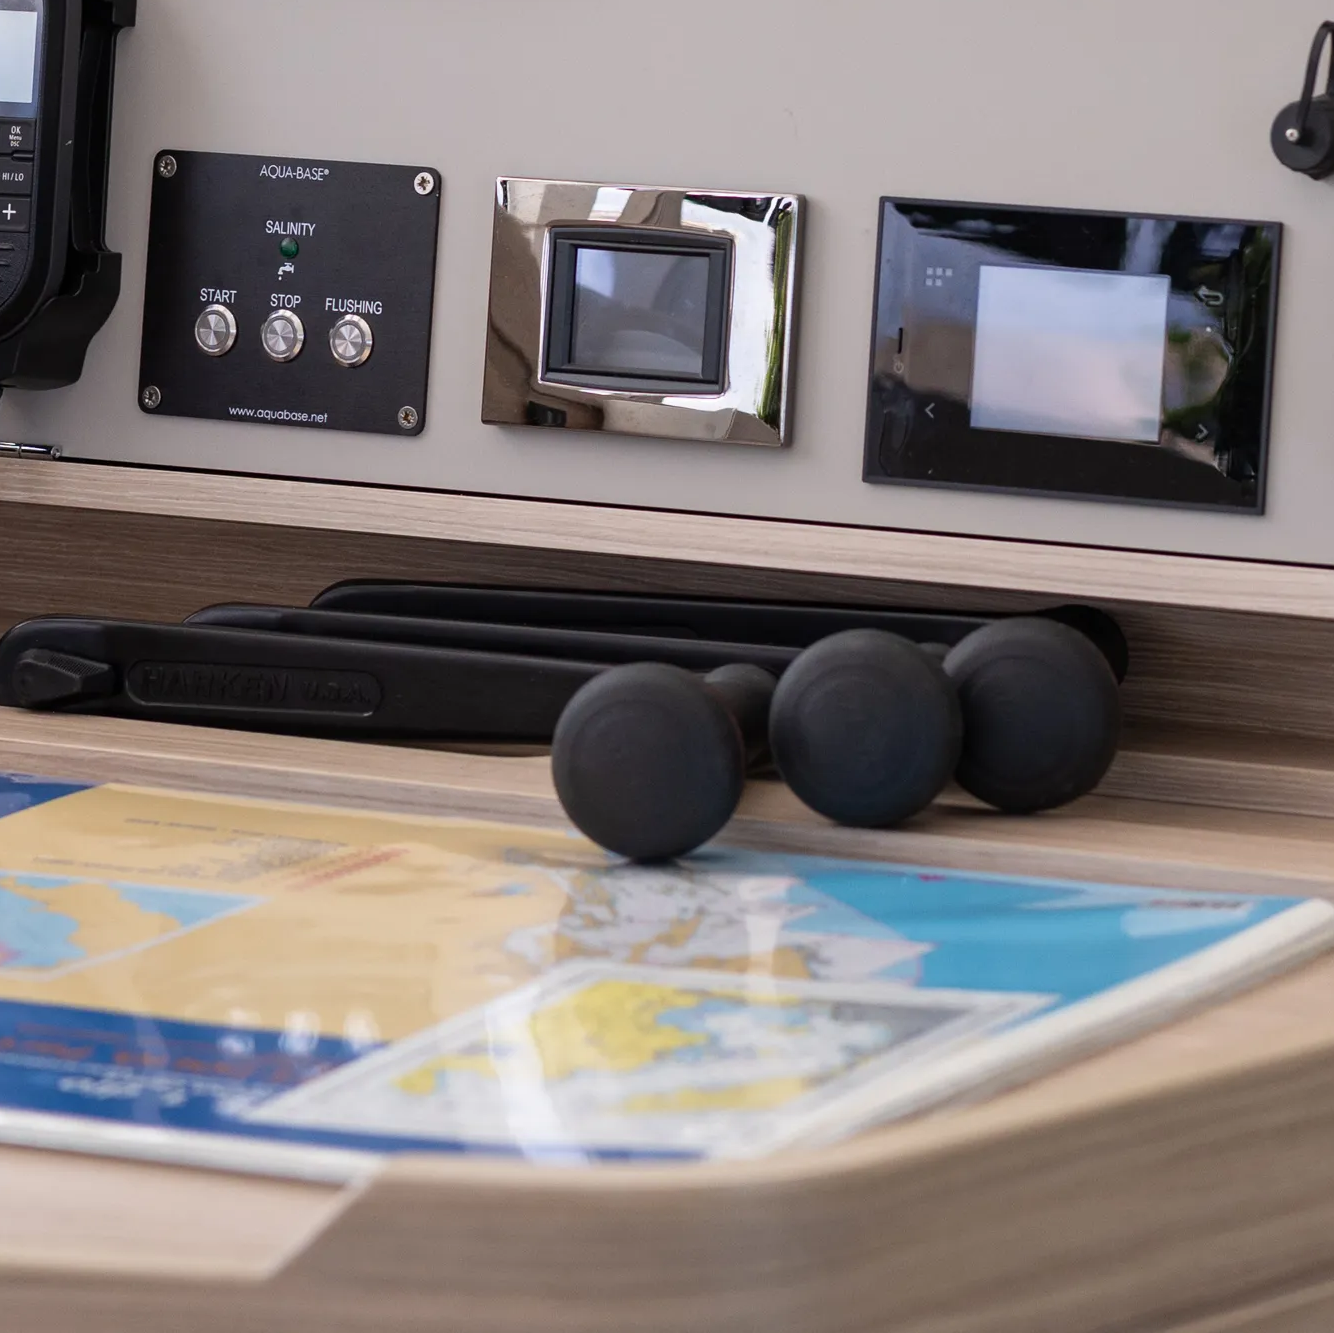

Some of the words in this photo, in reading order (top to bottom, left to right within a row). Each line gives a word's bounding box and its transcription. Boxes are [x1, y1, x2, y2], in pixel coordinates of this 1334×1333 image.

[10, 126, 21, 134] OK
[265, 220, 316, 237] SALINITY
[200, 288, 237, 303] START
[270, 294, 302, 308] STOP
[325, 297, 383, 315] FLUSHING
[229, 405, 328, 423] www.aquabase.net
